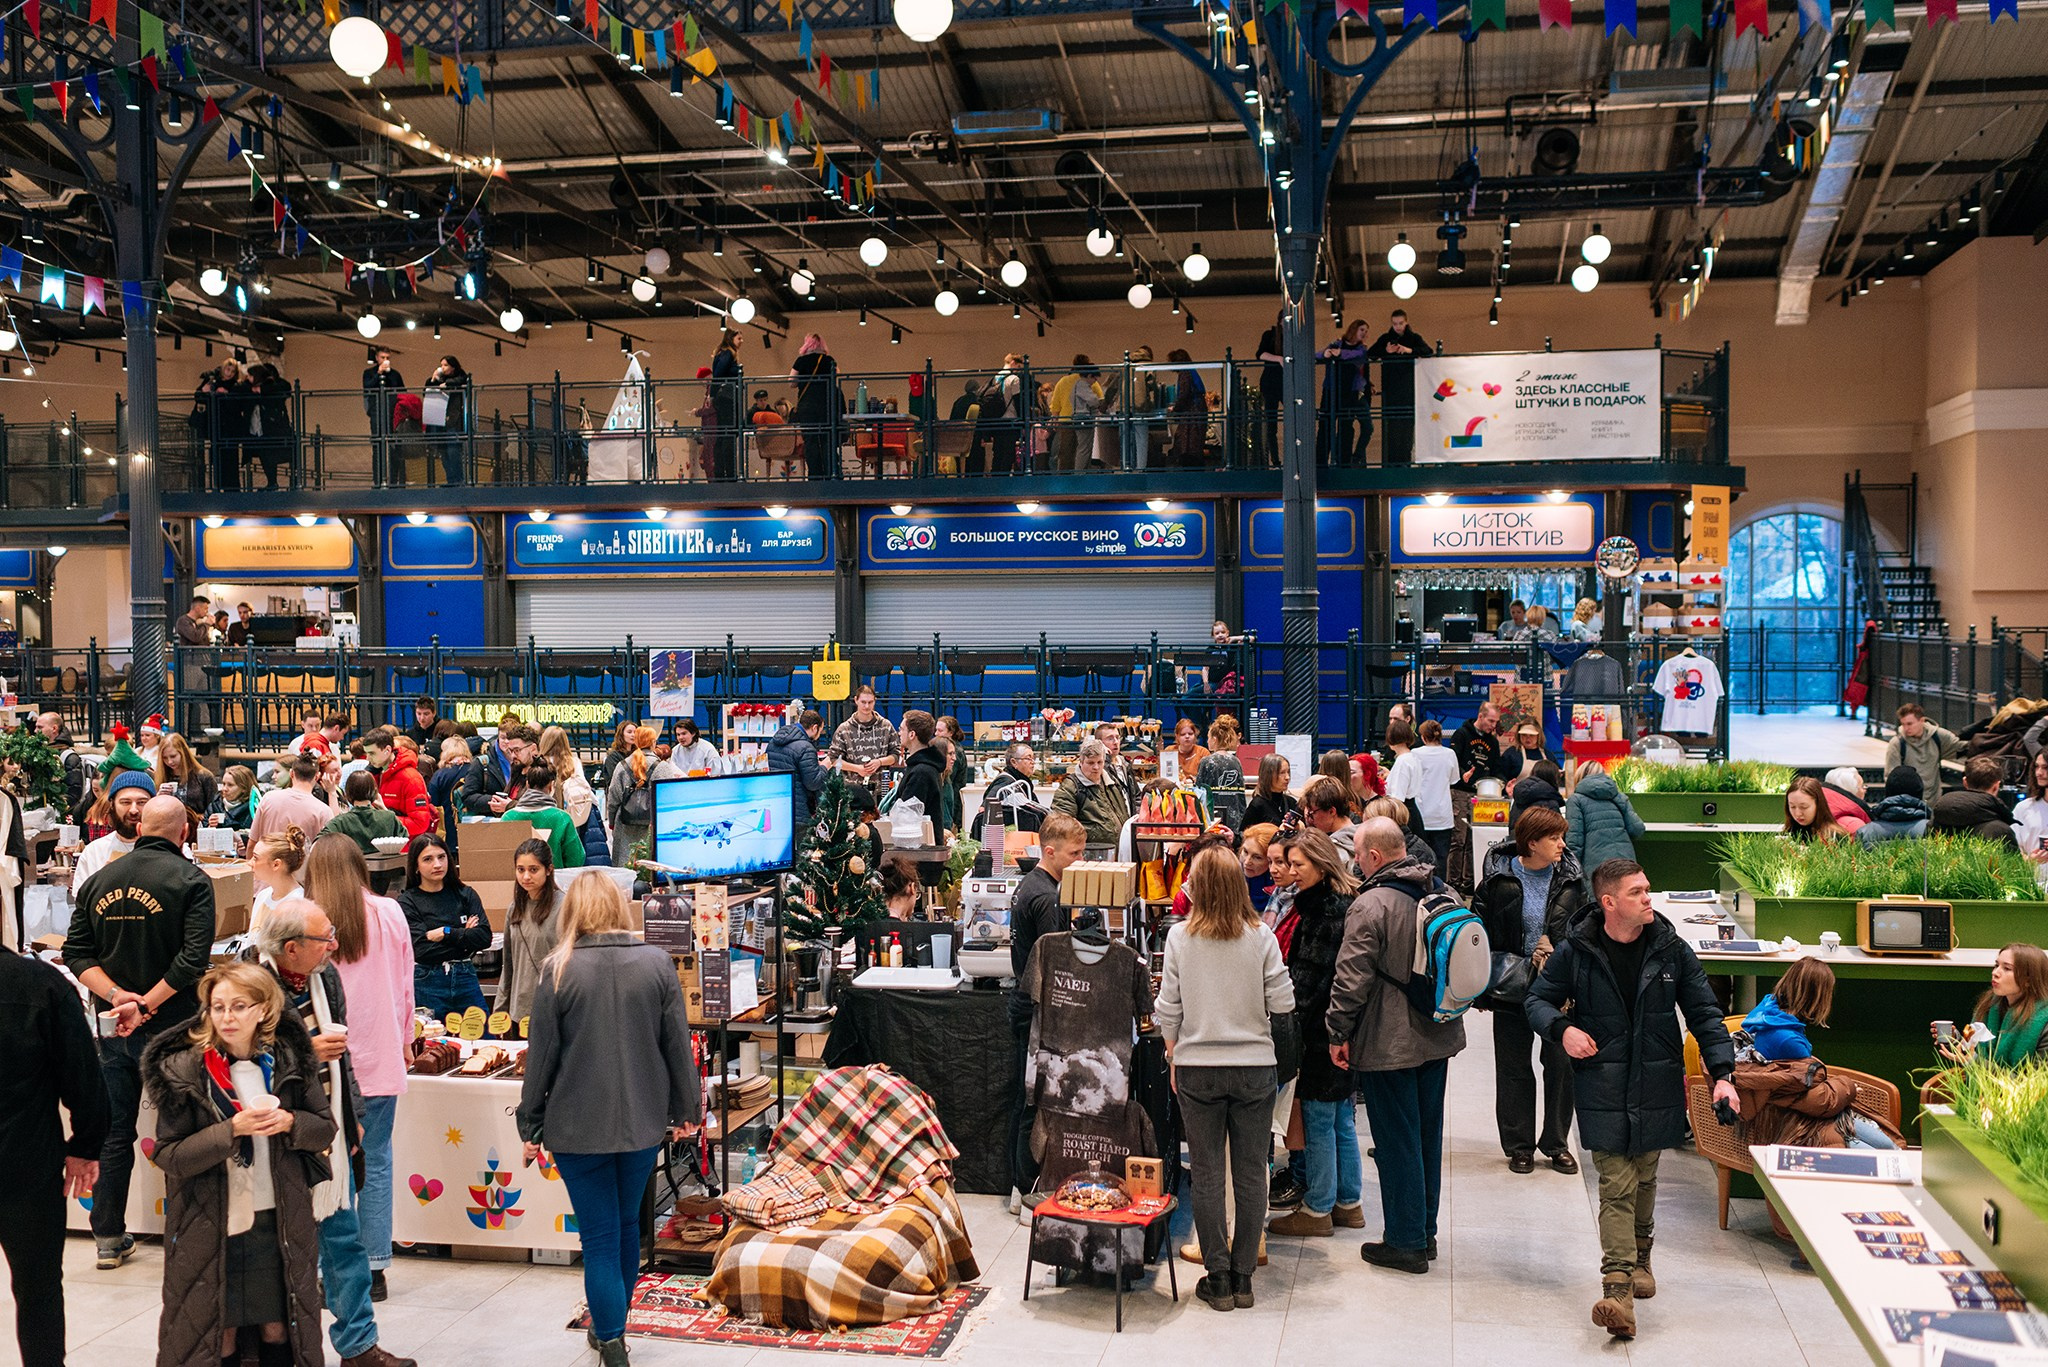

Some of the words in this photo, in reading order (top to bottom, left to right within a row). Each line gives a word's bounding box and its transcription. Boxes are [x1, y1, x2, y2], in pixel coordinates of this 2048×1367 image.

[1515, 369, 1531, 382] 2
[1515, 385, 1557, 397] ЗДЕСЬ
[1560, 382, 1630, 394] КЛАССНЫЕ
[1515, 398, 1570, 409] ШТУЧКИ
[1573, 397, 1581, 407] В
[1585, 395, 1646, 407] ПОДАРОК
[1462, 512, 1533, 529] ИСТОК
[526, 534, 564, 544] FRIENDS
[627, 529, 705, 554] SIBBITTER
[761, 539, 780, 548] ДЛЯ
[780, 536, 812, 548] ДРУЗЕЙ
[777, 531, 794, 539] БАР
[950, 532, 1015, 543] БОЛЬШОЕ
[1018, 531, 1079, 542] РУССКОЕ
[1082, 529, 1119, 542] ВИНО
[1433, 530, 1564, 547] КОЛЛЕКТИВ
[536, 543, 554, 552] BAR
[1085, 546, 1094, 554] by
[1095, 542, 1127, 555] simple
[95, 888, 123, 916] FRED
[126, 886, 164, 915] PERRY
[1053, 975, 1091, 992] NAEB
[1063, 1132, 1087, 1141] TOGGLE
[1062, 1138, 1098, 1151] ROAST
[1099, 1142, 1131, 1156] HARD
[1062, 1148, 1082, 1159] FLY
[1083, 1151, 1111, 1163] HIGH
